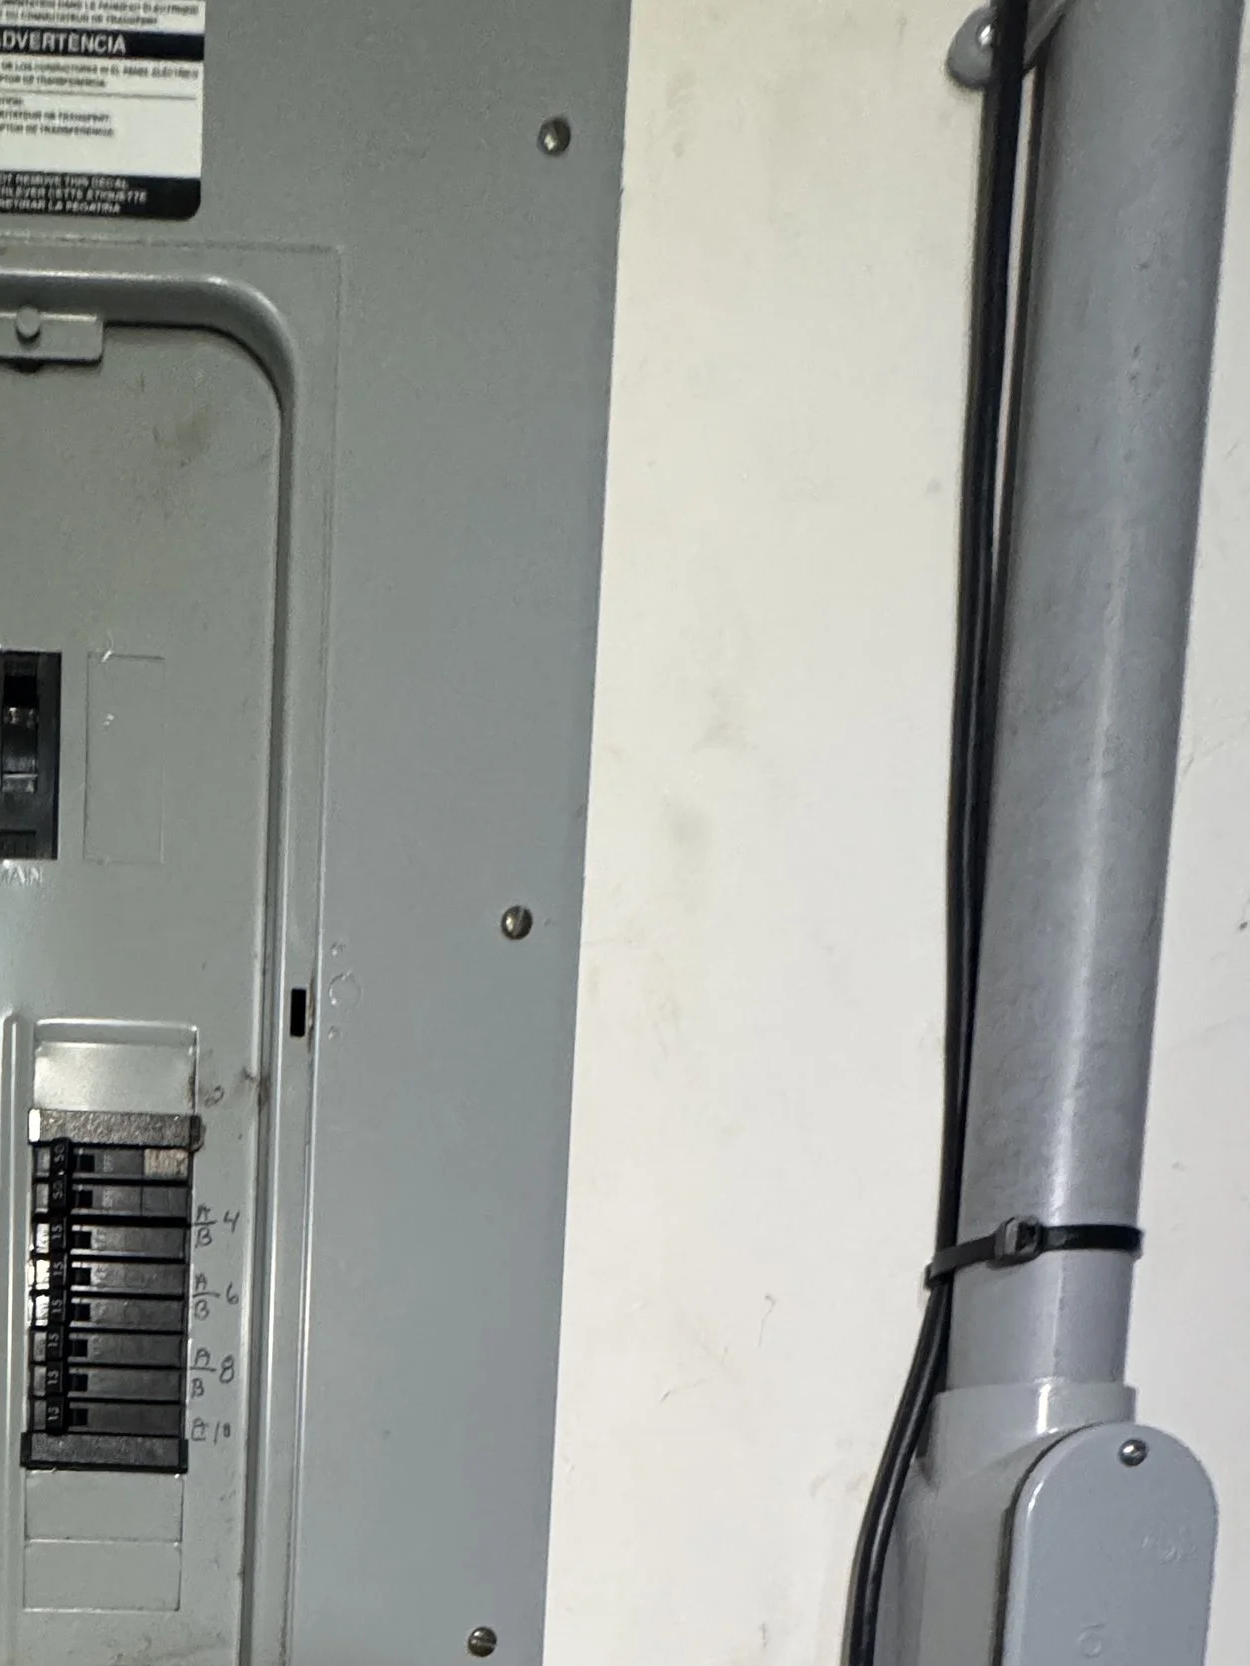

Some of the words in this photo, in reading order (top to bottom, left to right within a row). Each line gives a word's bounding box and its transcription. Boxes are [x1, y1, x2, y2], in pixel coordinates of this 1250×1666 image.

[222, 1209, 241, 1233] 4
[51, 1224, 63, 1241] 15
[194, 1226, 213, 1249] B
[52, 1261, 64, 1277] 15
[225, 1281, 240, 1305] 6
[51, 1298, 62, 1314] 15
[48, 1333, 59, 1348] 15
[194, 1347, 211, 1367] A
[219, 1353, 236, 1385] 8
[191, 1377, 206, 1399] B
